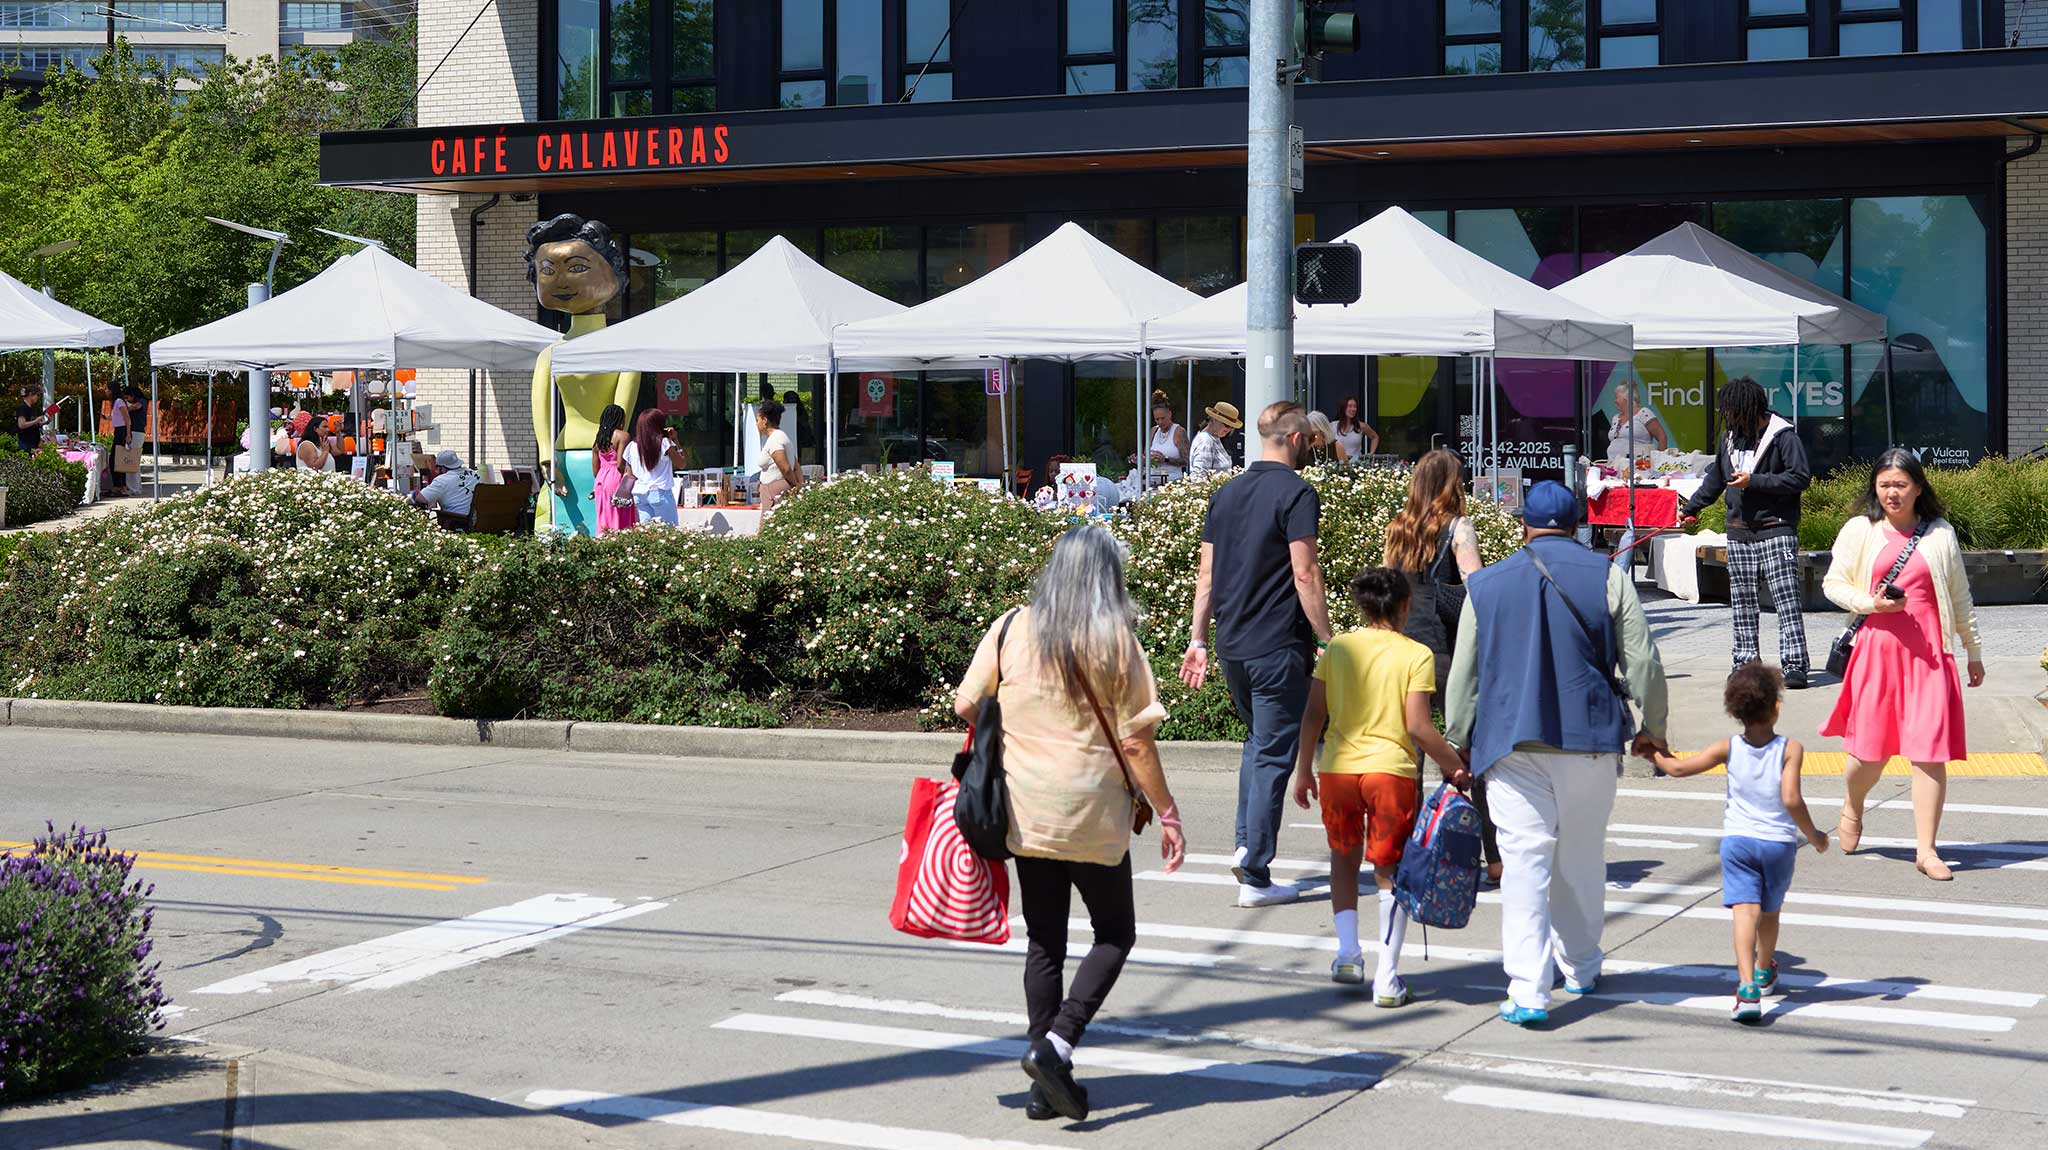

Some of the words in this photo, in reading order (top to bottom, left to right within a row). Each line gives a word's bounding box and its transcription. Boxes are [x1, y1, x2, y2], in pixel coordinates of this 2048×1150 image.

[431, 127, 507, 175] CAFÉ
[537, 124, 729, 171] CALAVERAS
[1647, 380, 1705, 406] Find
[1784, 381, 1844, 406] YES
[1931, 447, 1970, 458] Vulcan
[1505, 456, 1565, 469] AVAILABL
